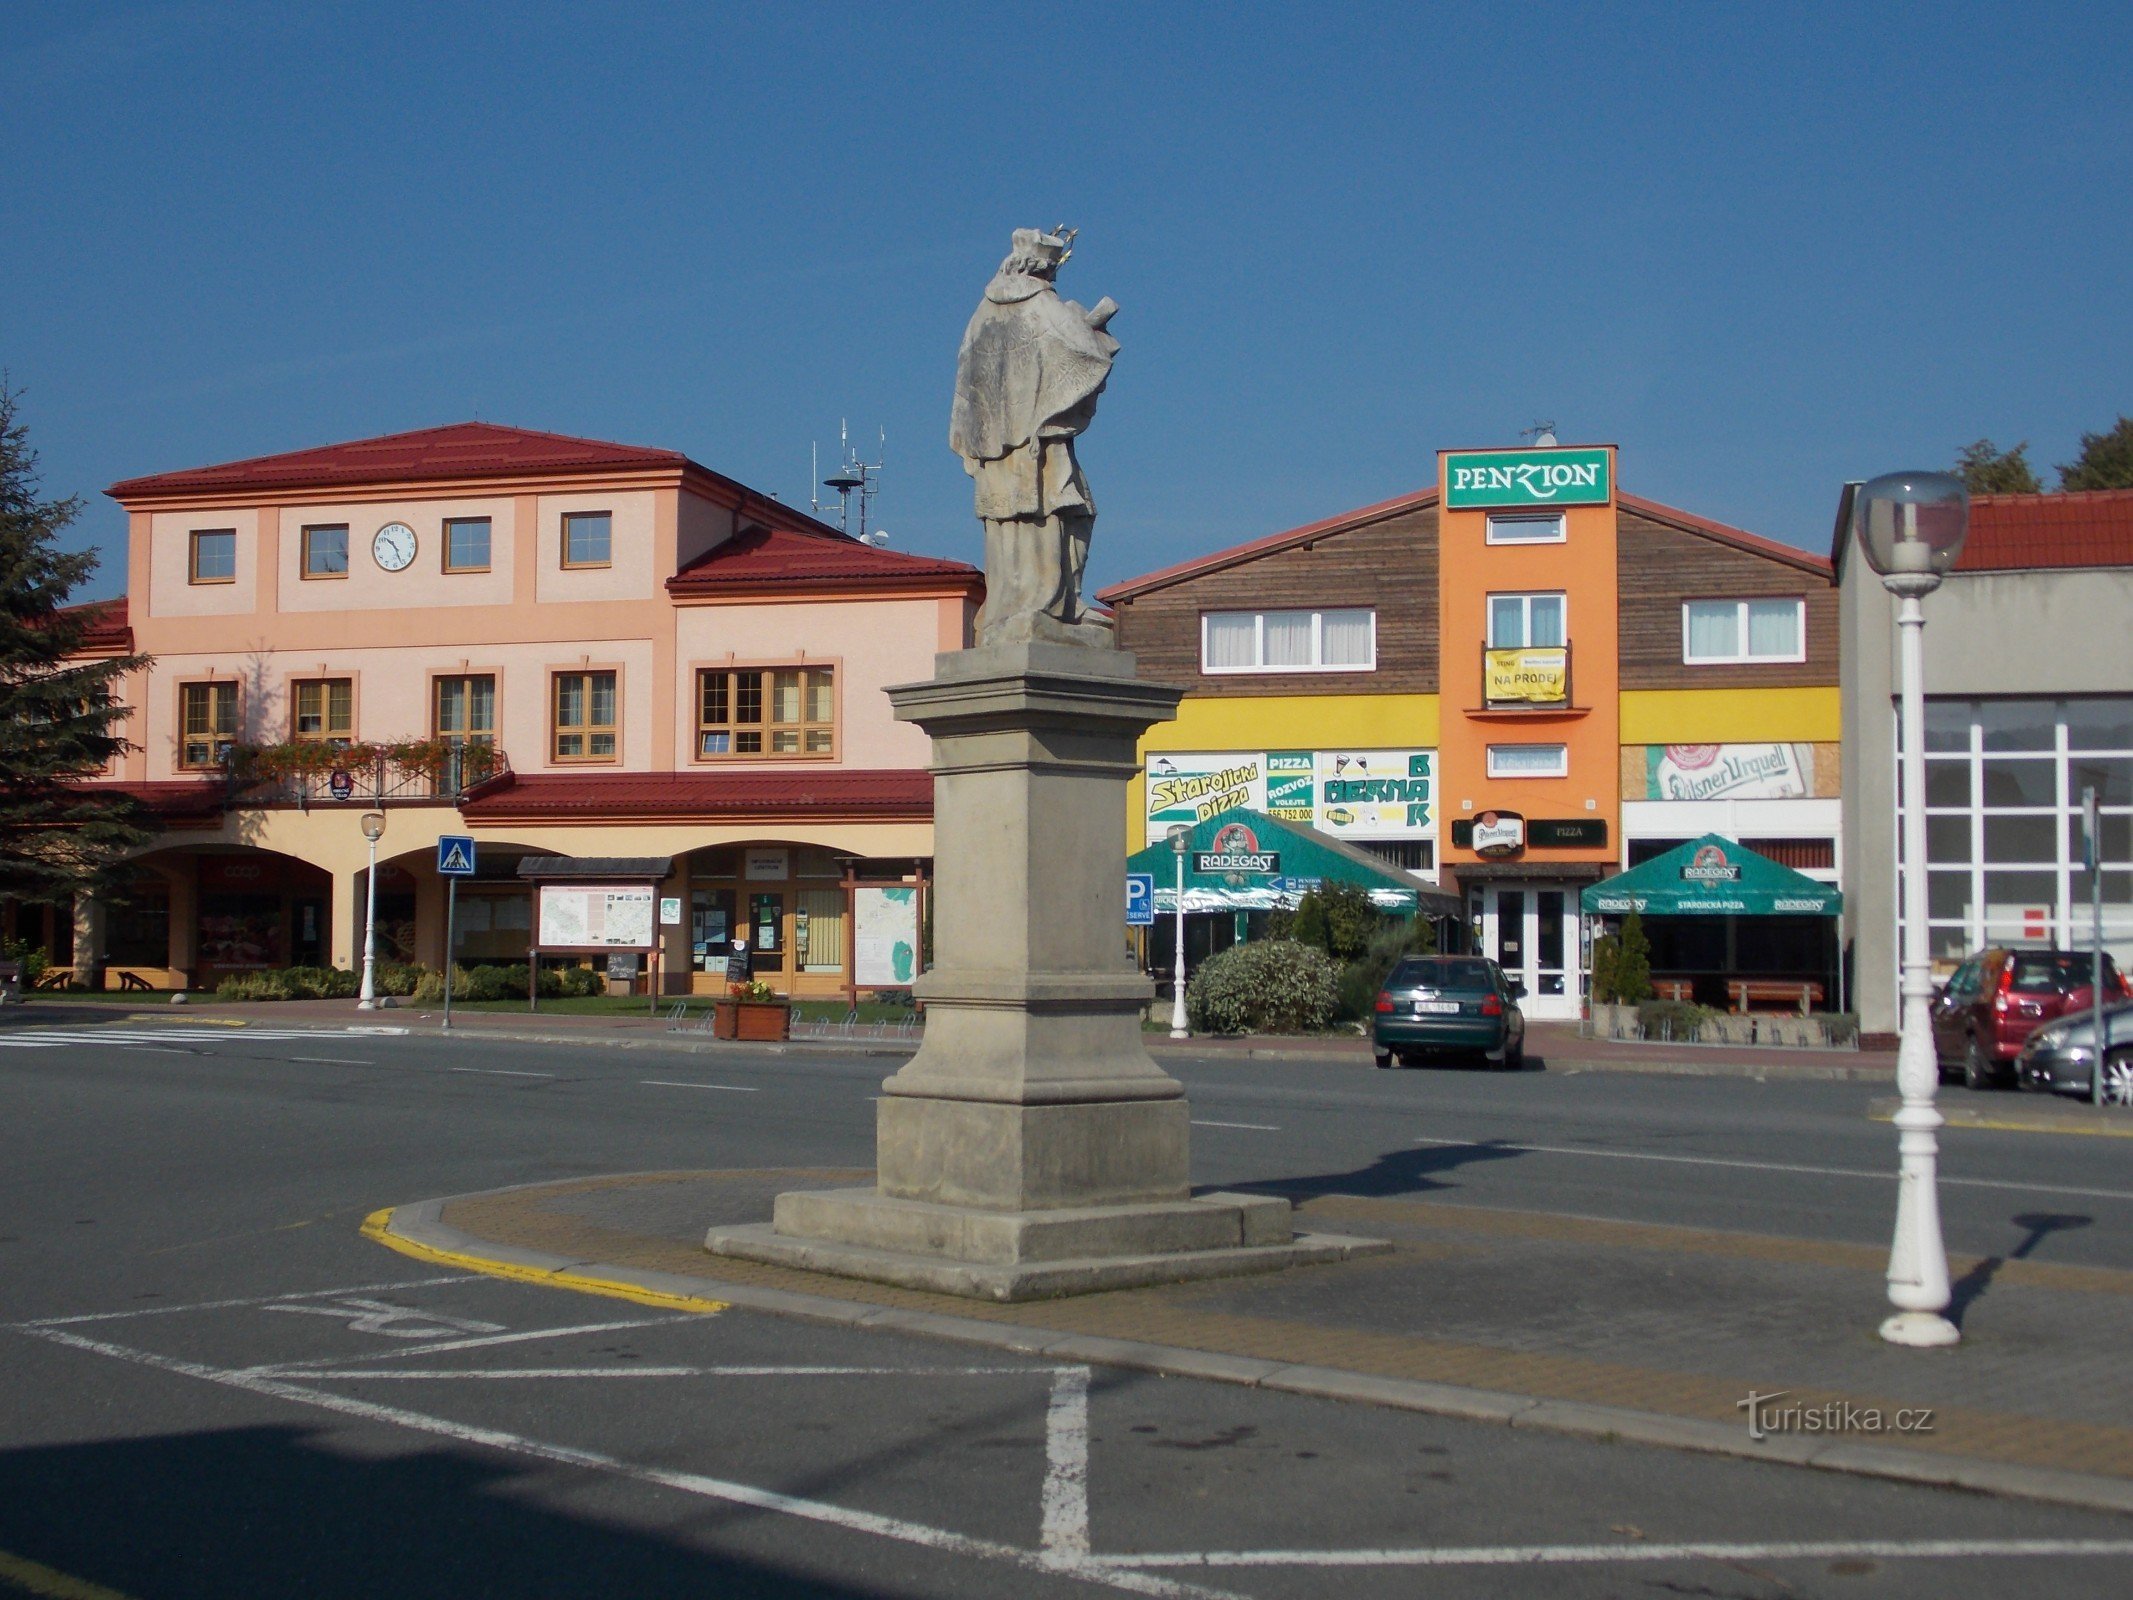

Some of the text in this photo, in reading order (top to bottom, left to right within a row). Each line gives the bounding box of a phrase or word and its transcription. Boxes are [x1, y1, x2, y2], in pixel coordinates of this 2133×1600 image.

[1454, 463, 1600, 498] PENZION
[1494, 673, 1557, 685] NA PRODEJ
[1269, 758, 1312, 770] PIZZA
[1668, 745, 1787, 800] Pilsner Urquell
[1268, 776, 1313, 800] ROZVOZ
[1284, 809, 1297, 820] 752
[1299, 809, 1313, 820] 000
[1557, 826, 1583, 837] PIZZA
[1200, 855, 1275, 872] RADEGAST
[1684, 867, 1738, 879] RADEGAST
[1723, 901, 1744, 910] PIZZA
[1774, 899, 1826, 911] RADEGAST
